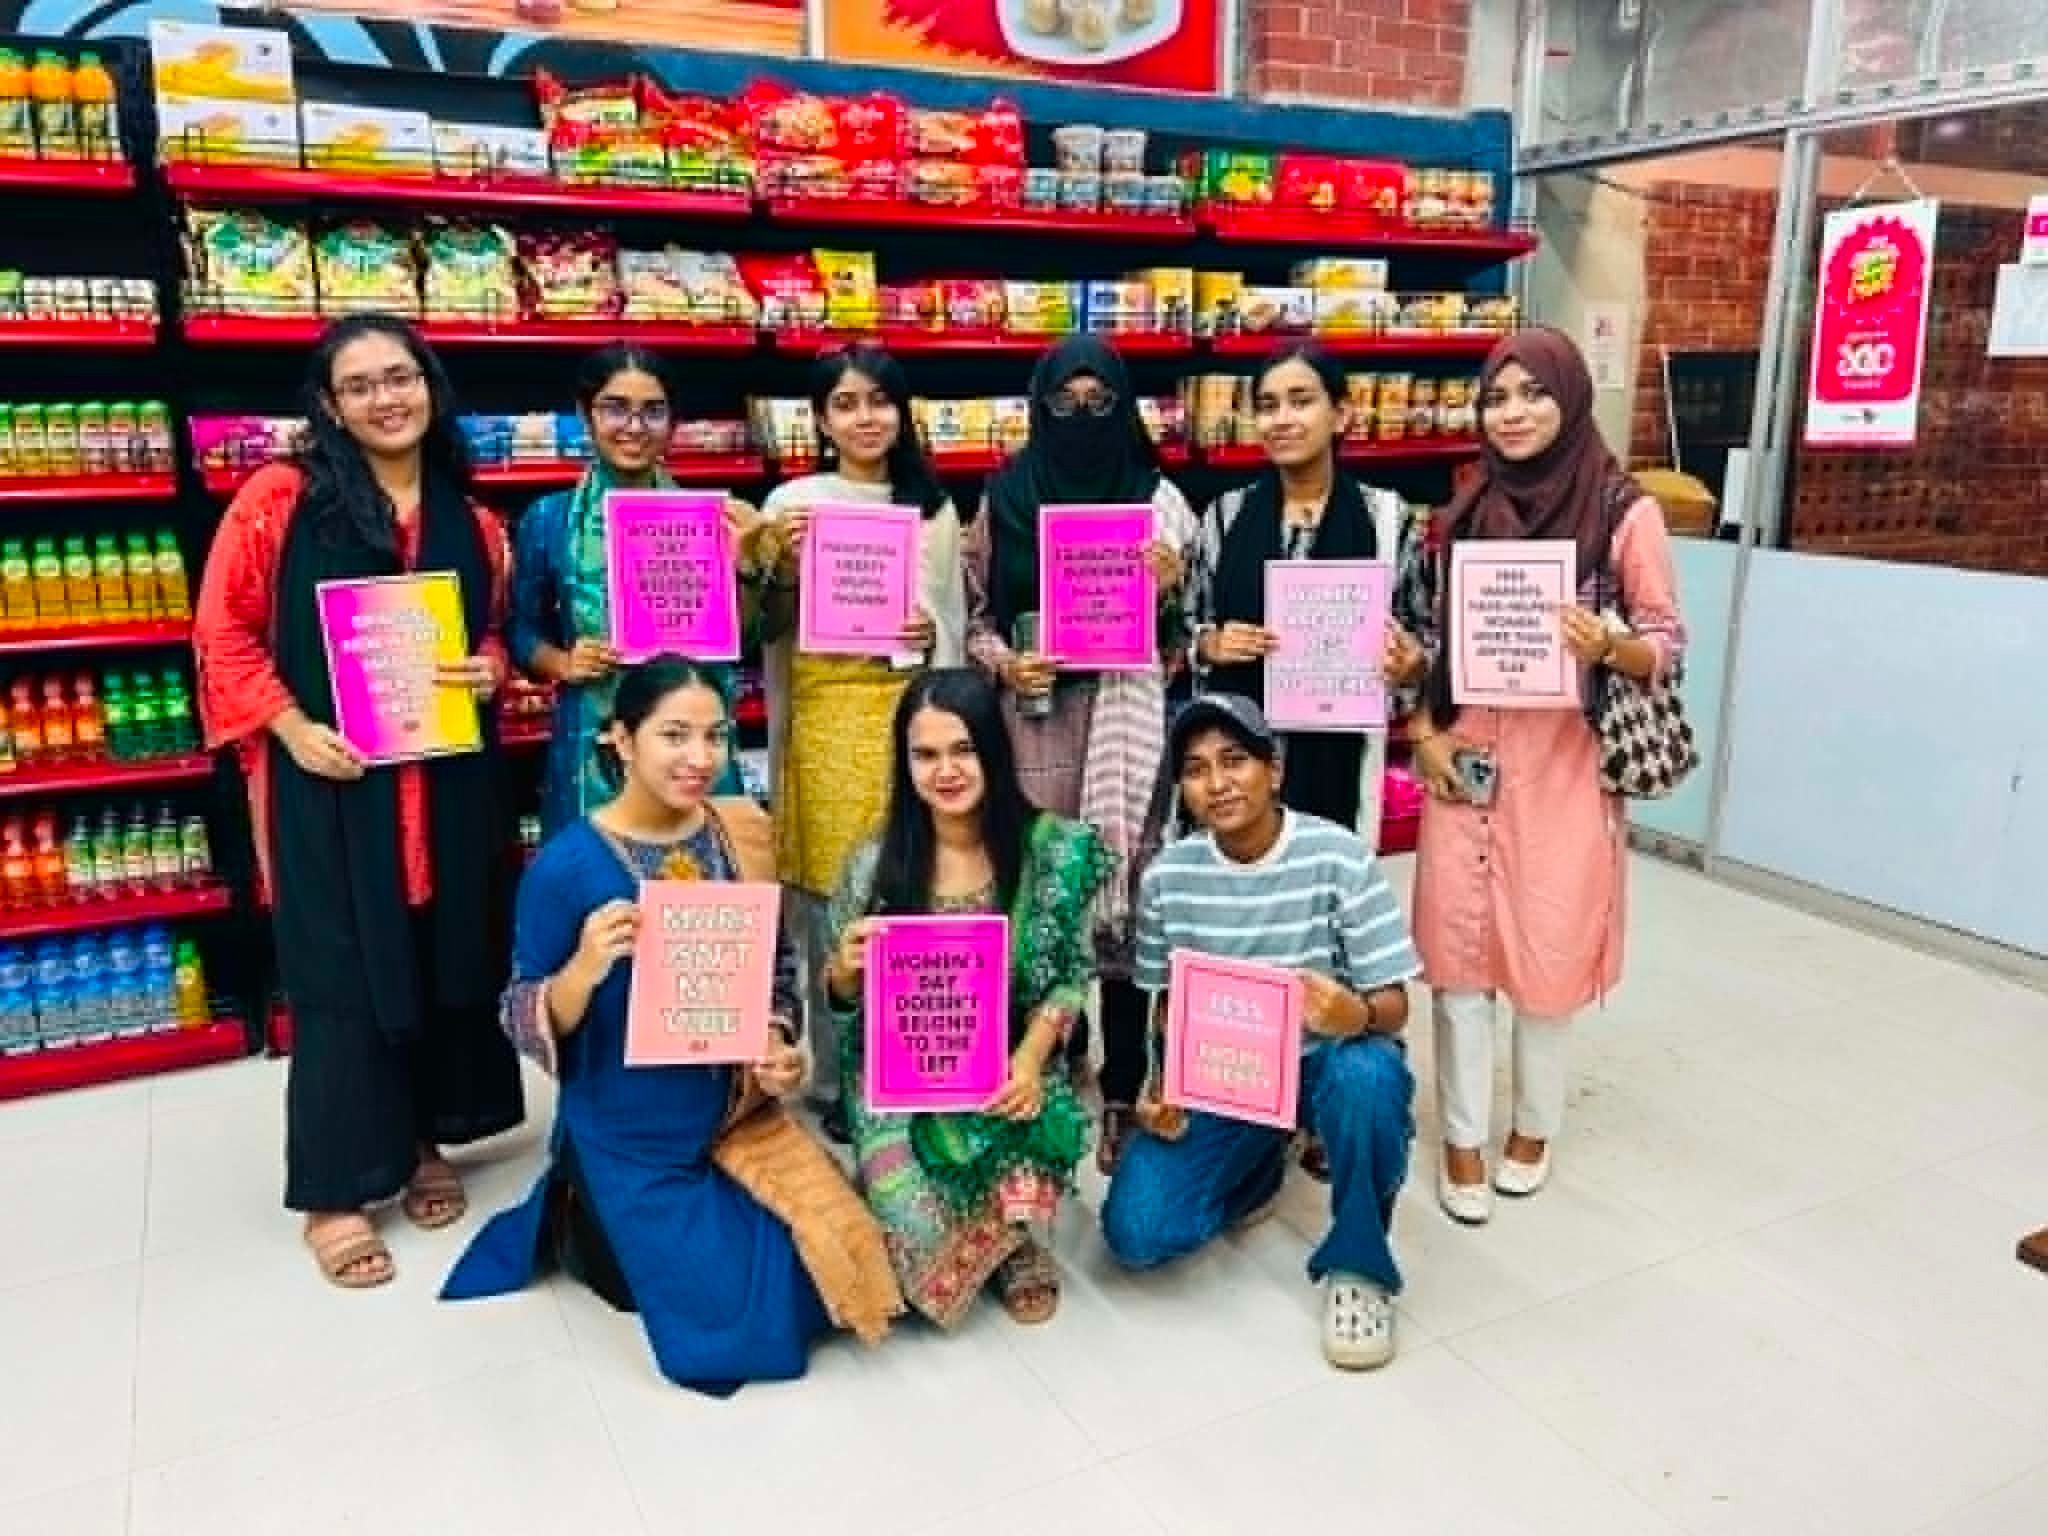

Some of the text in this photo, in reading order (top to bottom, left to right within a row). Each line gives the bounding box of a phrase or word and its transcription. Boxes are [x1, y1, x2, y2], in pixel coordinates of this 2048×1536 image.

[889, 952, 985, 970] WOMEN'S
[918, 975, 958, 991] DAY
[895, 994, 978, 1012] DOESN'T
[898, 1015, 977, 1032] BELONG
[904, 1035, 970, 1052] TO THE
[918, 1055, 959, 1072] LEFT
